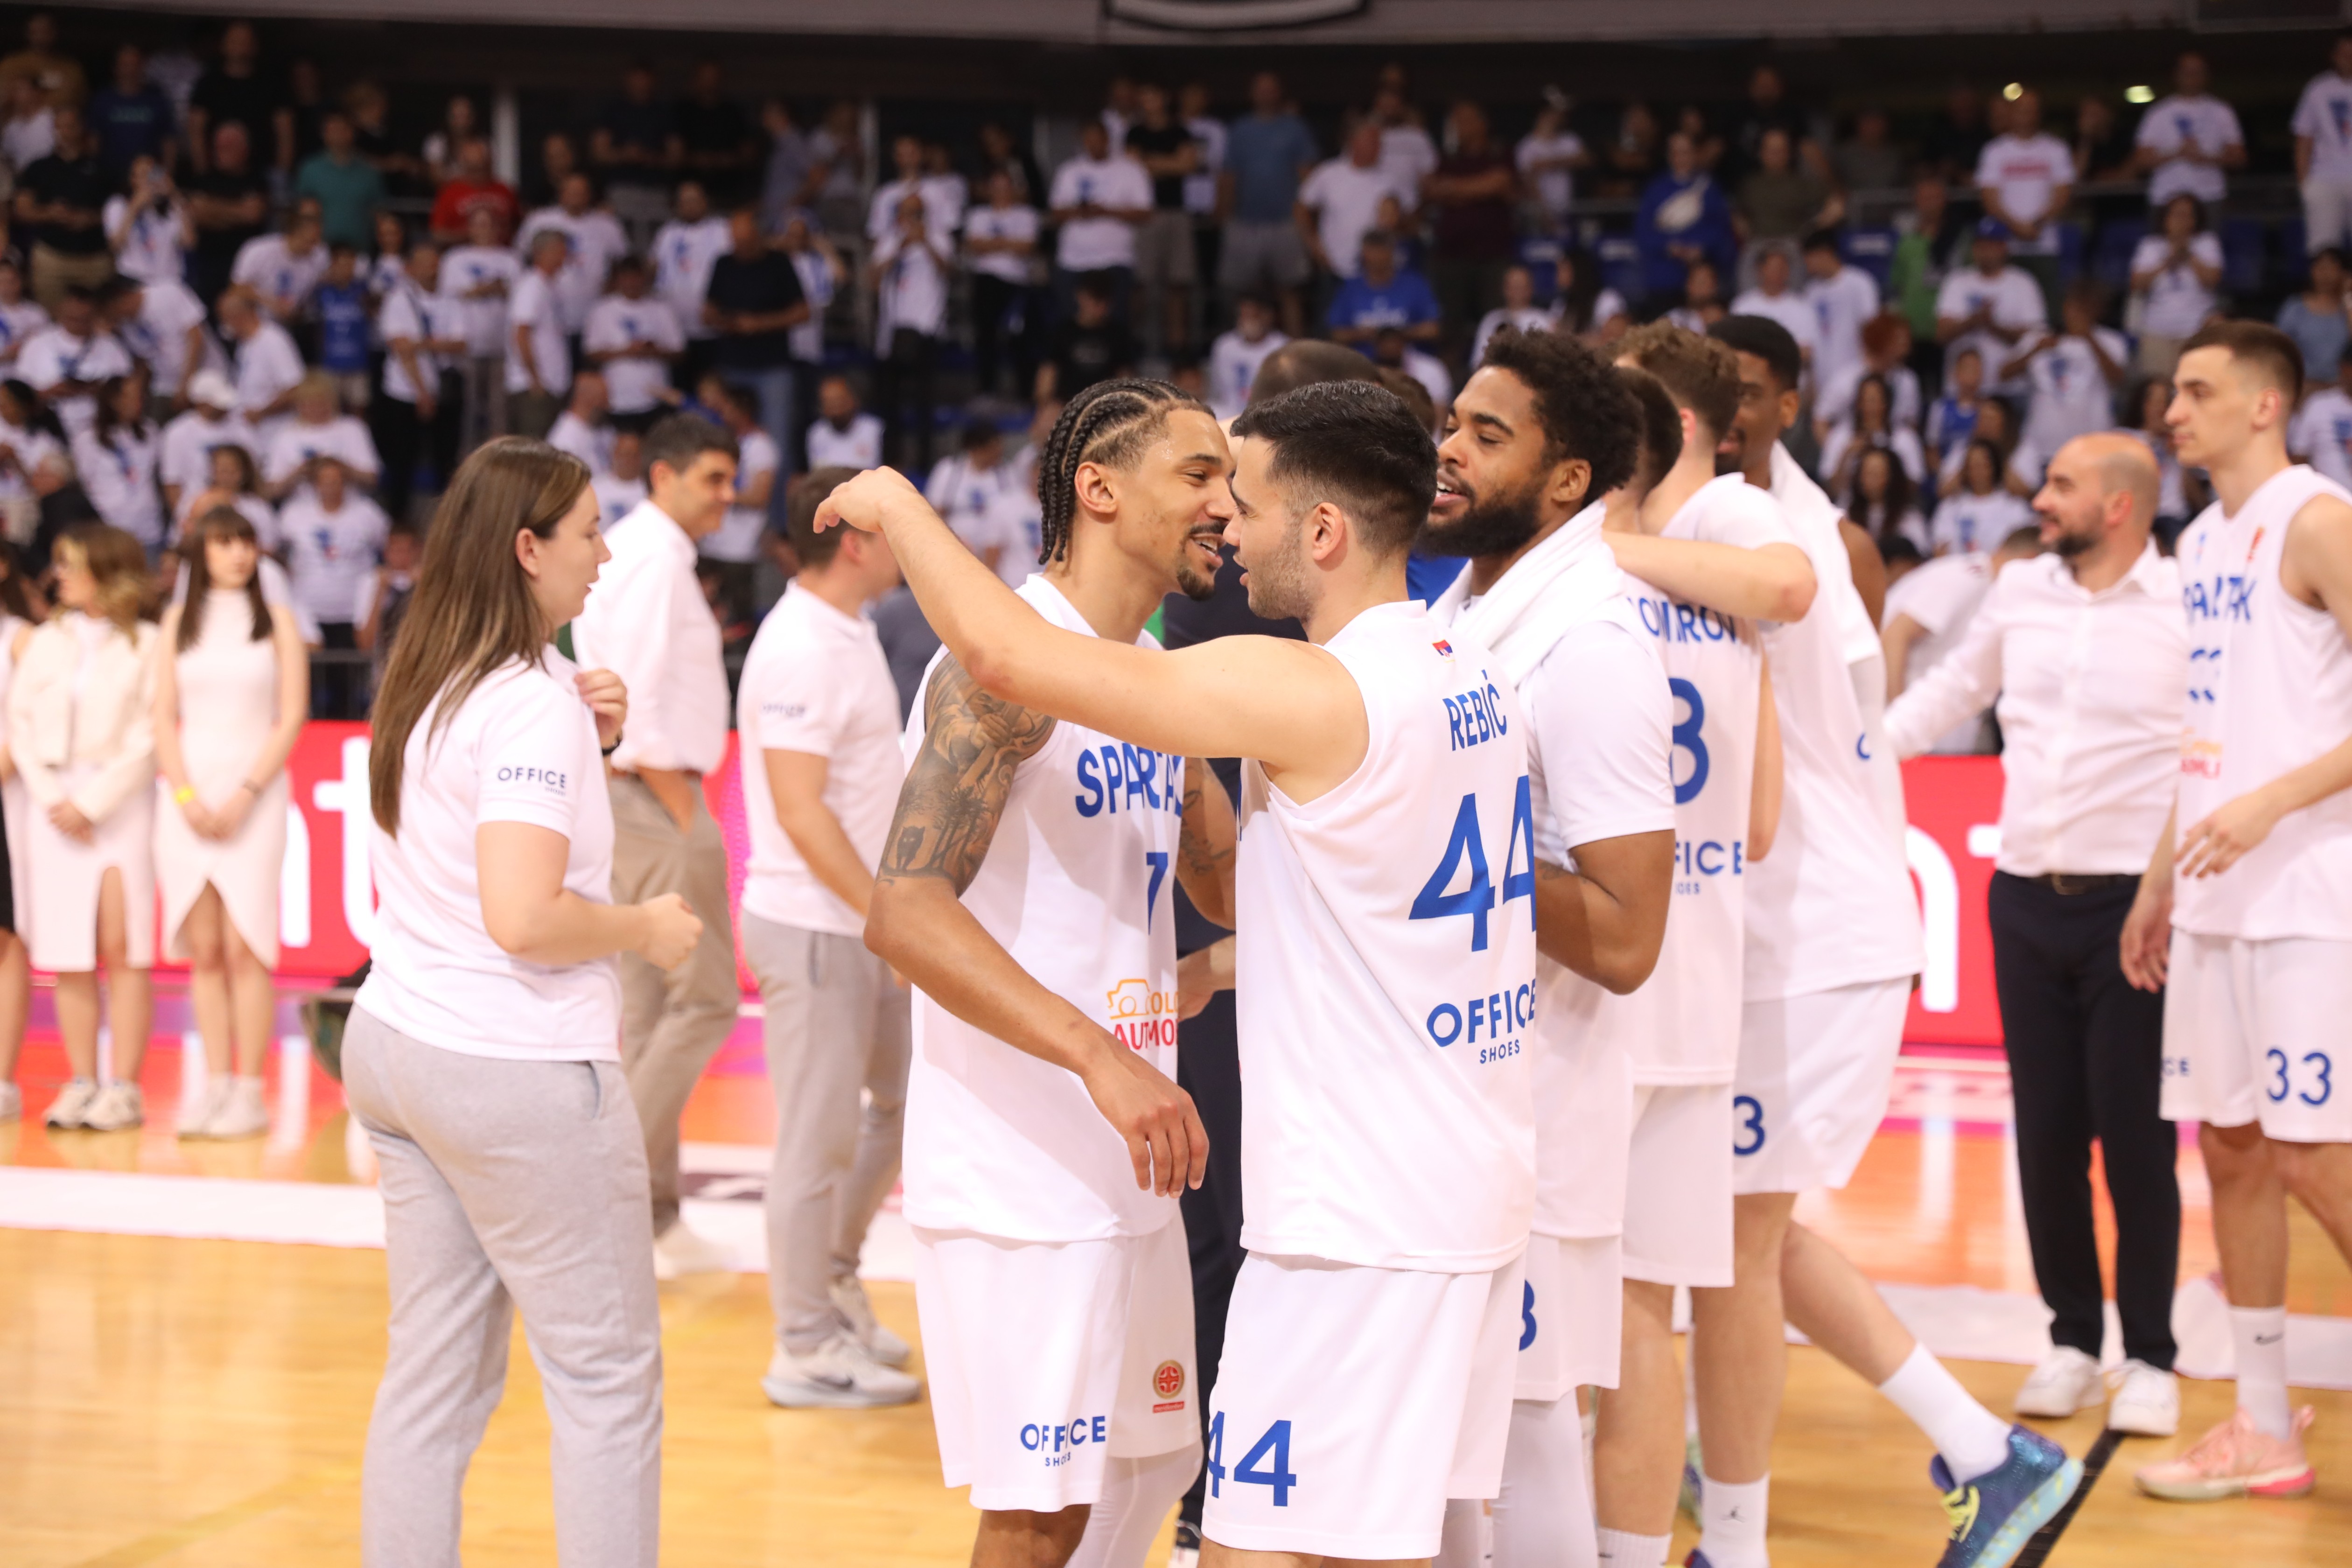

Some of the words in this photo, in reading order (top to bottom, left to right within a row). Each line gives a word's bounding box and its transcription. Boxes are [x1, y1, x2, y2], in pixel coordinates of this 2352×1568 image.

[1442, 669, 1507, 751] REBIĆ
[497, 767, 566, 789] OFFICE
[1146, 852, 1169, 935] 7
[1408, 775, 1536, 952] 44
[1427, 977, 1536, 1047] OFFICE
[1479, 1038, 1519, 1064] SHOES
[2266, 1048, 2331, 1106] 33
[1020, 1415, 1106, 1452] OFFICE
[1207, 1410, 1297, 1507] 44
